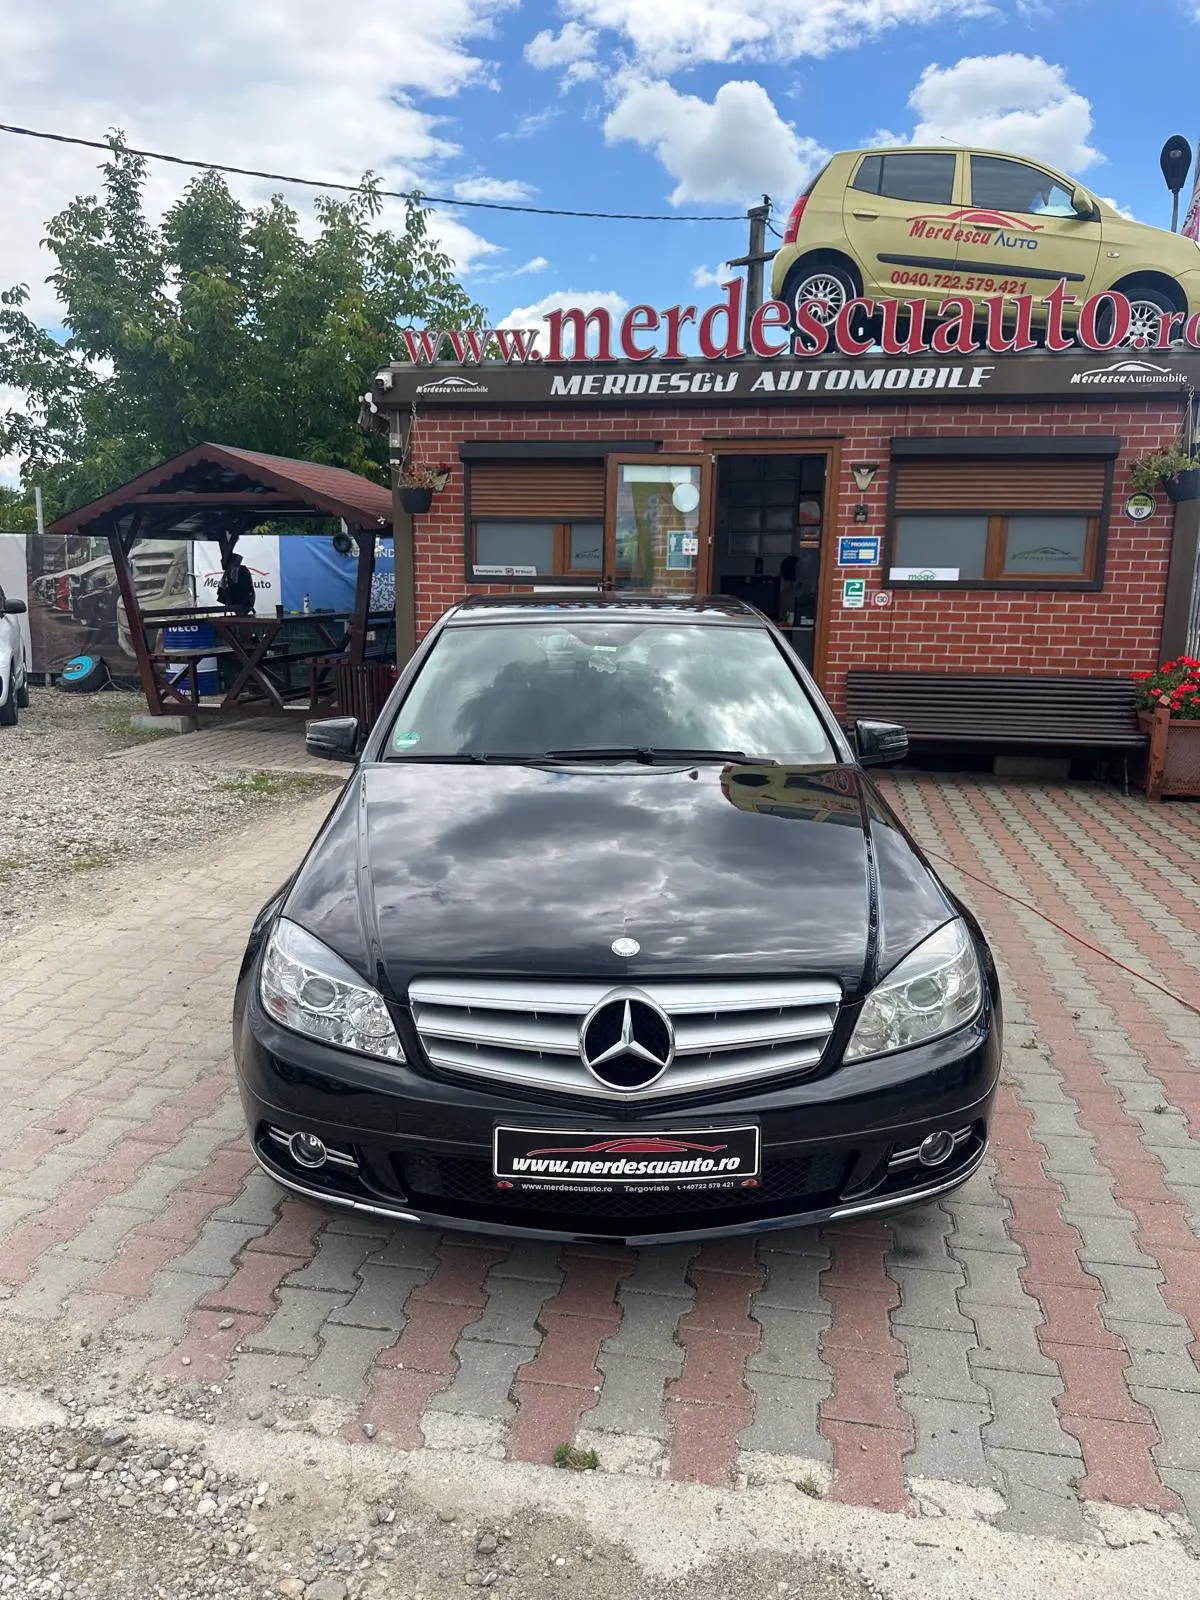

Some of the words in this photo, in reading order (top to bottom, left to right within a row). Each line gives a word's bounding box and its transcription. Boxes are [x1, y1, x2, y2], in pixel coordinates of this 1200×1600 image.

[909, 220, 992, 246] Merdescu
[890, 270, 1028, 295] 0040.722.579.421
[549, 370, 739, 396] MERDESCU
[749, 366, 997, 393] AUTOMOBILE
[253, 579, 272, 590] uto
[511, 1157, 741, 1175] www.merdescuauto.ro
[521, 1182, 613, 1193] www.merdescuauto.ro
[624, 1184, 670, 1194] Targoviste
